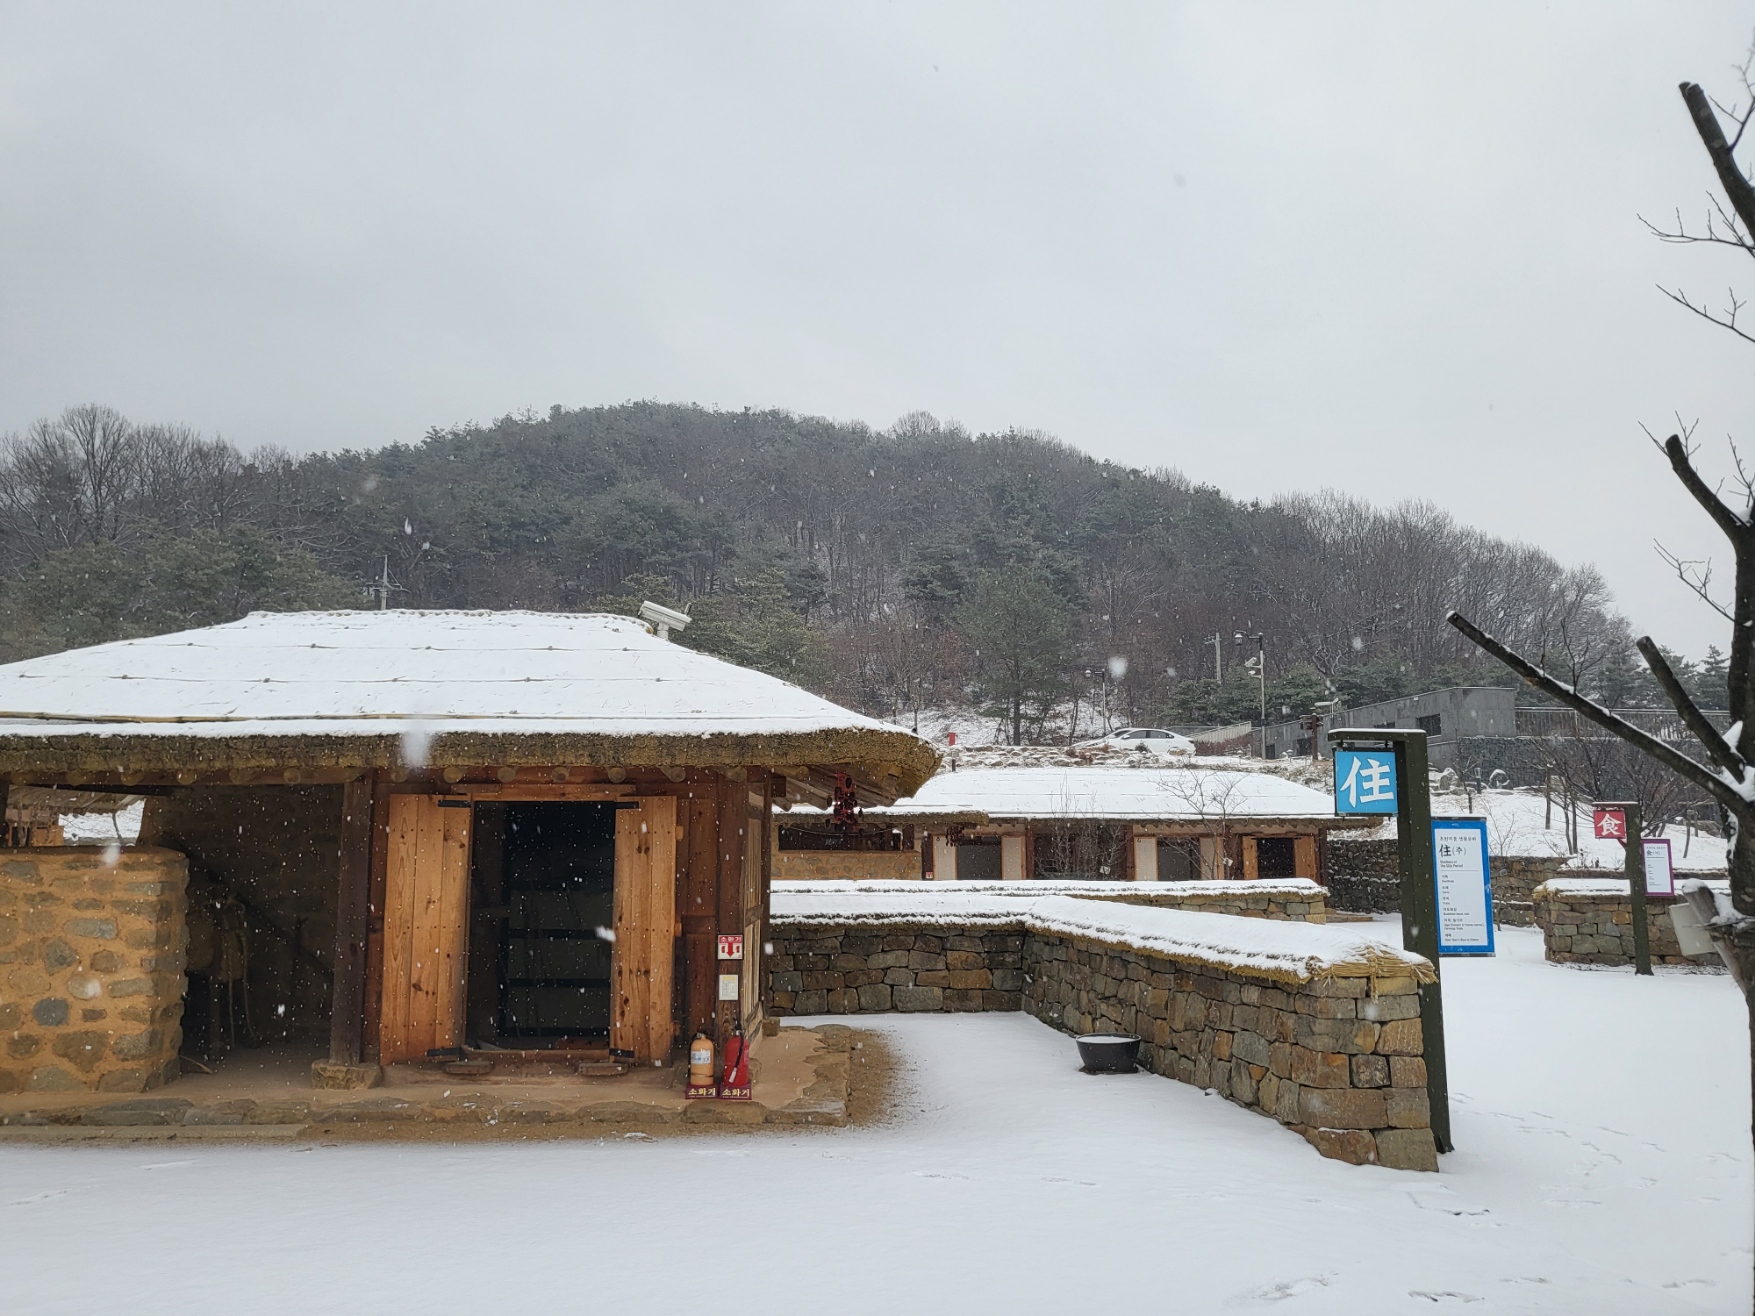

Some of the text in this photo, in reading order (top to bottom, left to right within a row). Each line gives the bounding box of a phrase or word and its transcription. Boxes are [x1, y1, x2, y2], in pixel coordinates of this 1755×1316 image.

[1340, 755, 1394, 809] 住
[1597, 812, 1622, 836] 食
[688, 1087, 716, 1097] 소화기
[722, 1088, 750, 1098] 소화기
